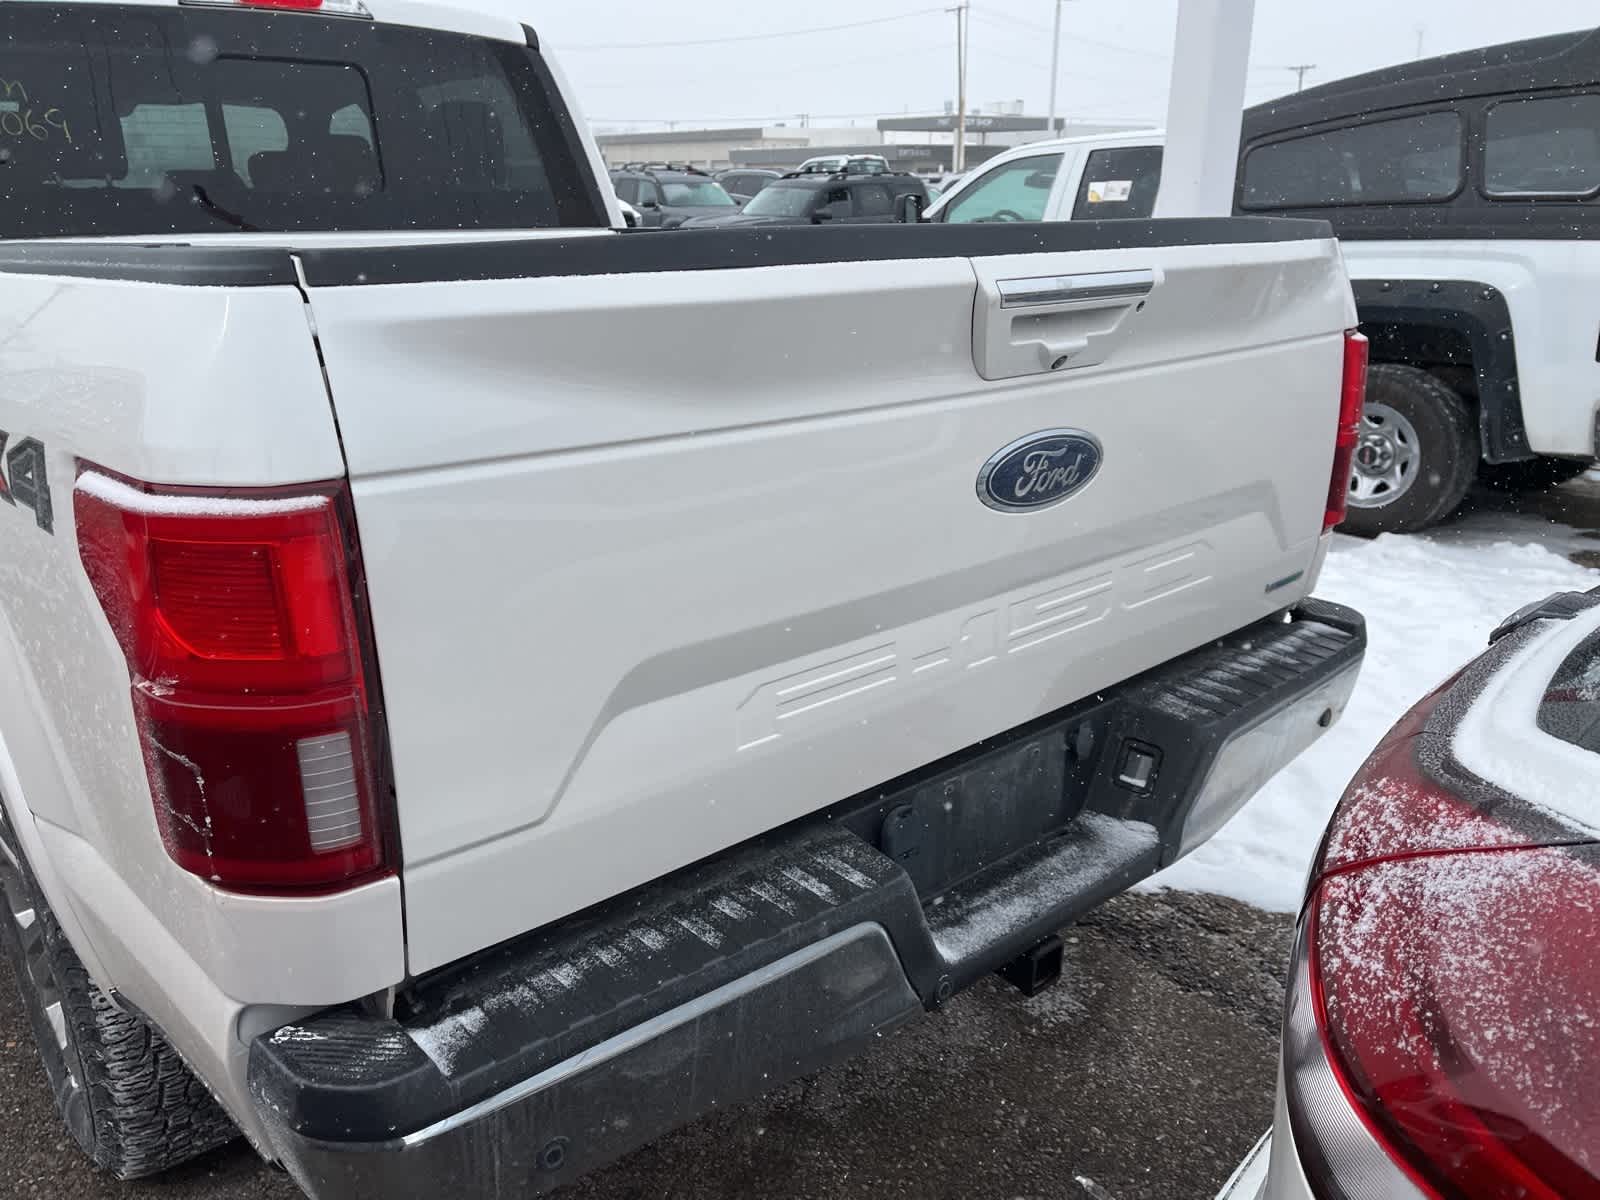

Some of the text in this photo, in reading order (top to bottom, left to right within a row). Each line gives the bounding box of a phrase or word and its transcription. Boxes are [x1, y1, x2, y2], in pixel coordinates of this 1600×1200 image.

[0, 108, 72, 144] 069
[1014, 446, 1083, 497] Ford
[736, 538, 1214, 752] F-150
